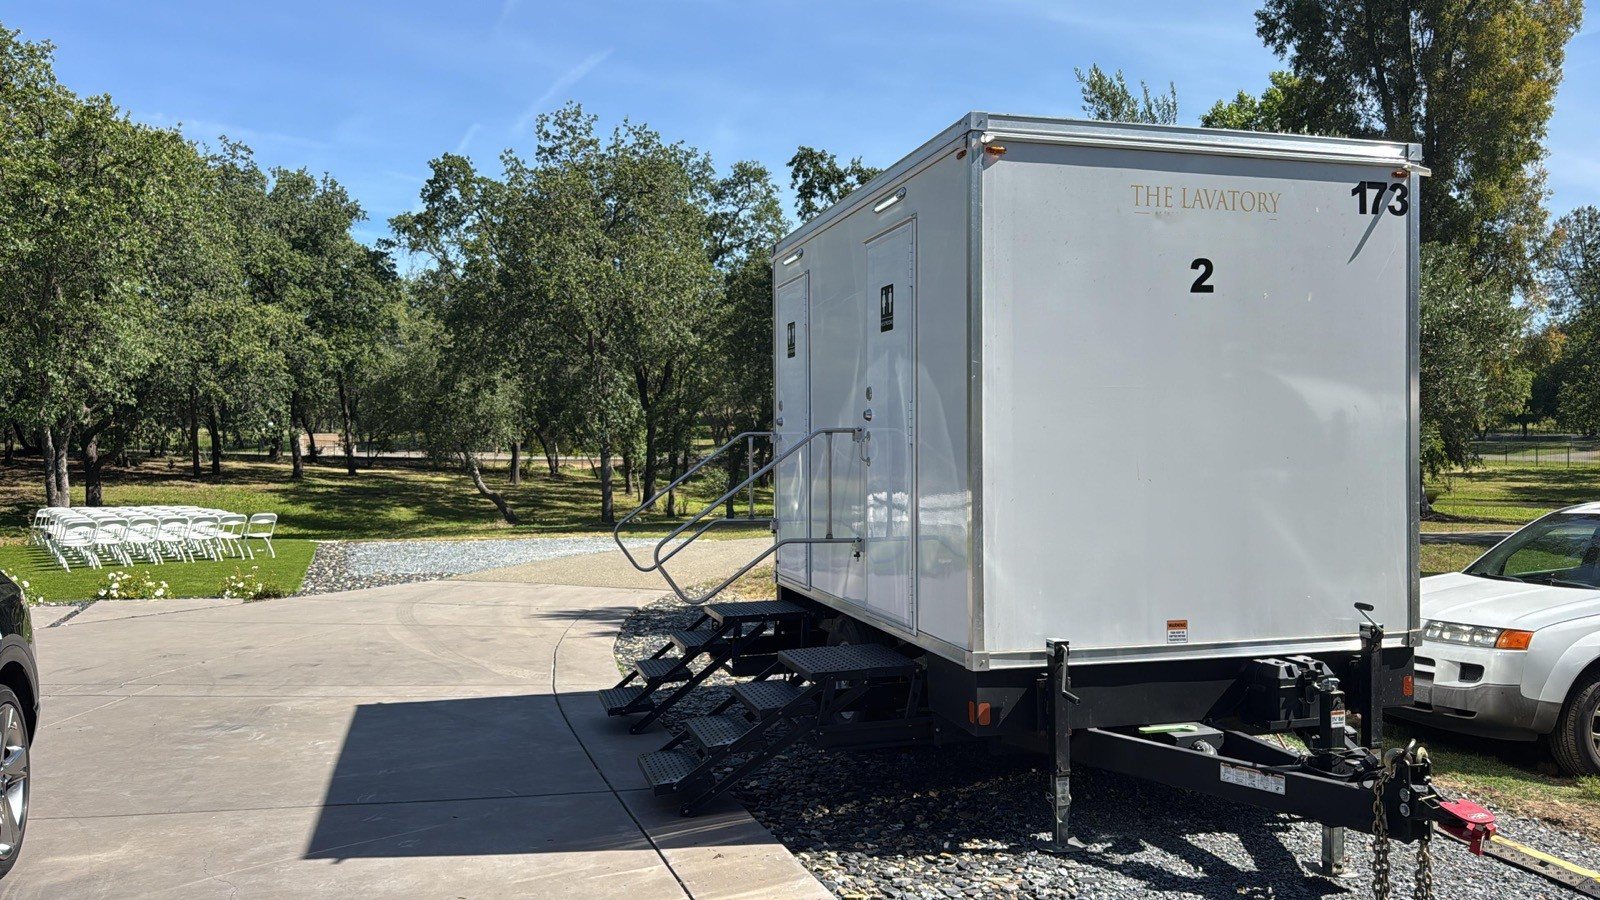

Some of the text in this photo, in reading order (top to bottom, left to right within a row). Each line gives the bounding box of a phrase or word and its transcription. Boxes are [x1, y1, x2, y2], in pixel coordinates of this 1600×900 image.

[1131, 184, 1282, 214] THE LAVATORY
[1351, 181, 1409, 216] 173
[1190, 258, 1214, 293] 2
